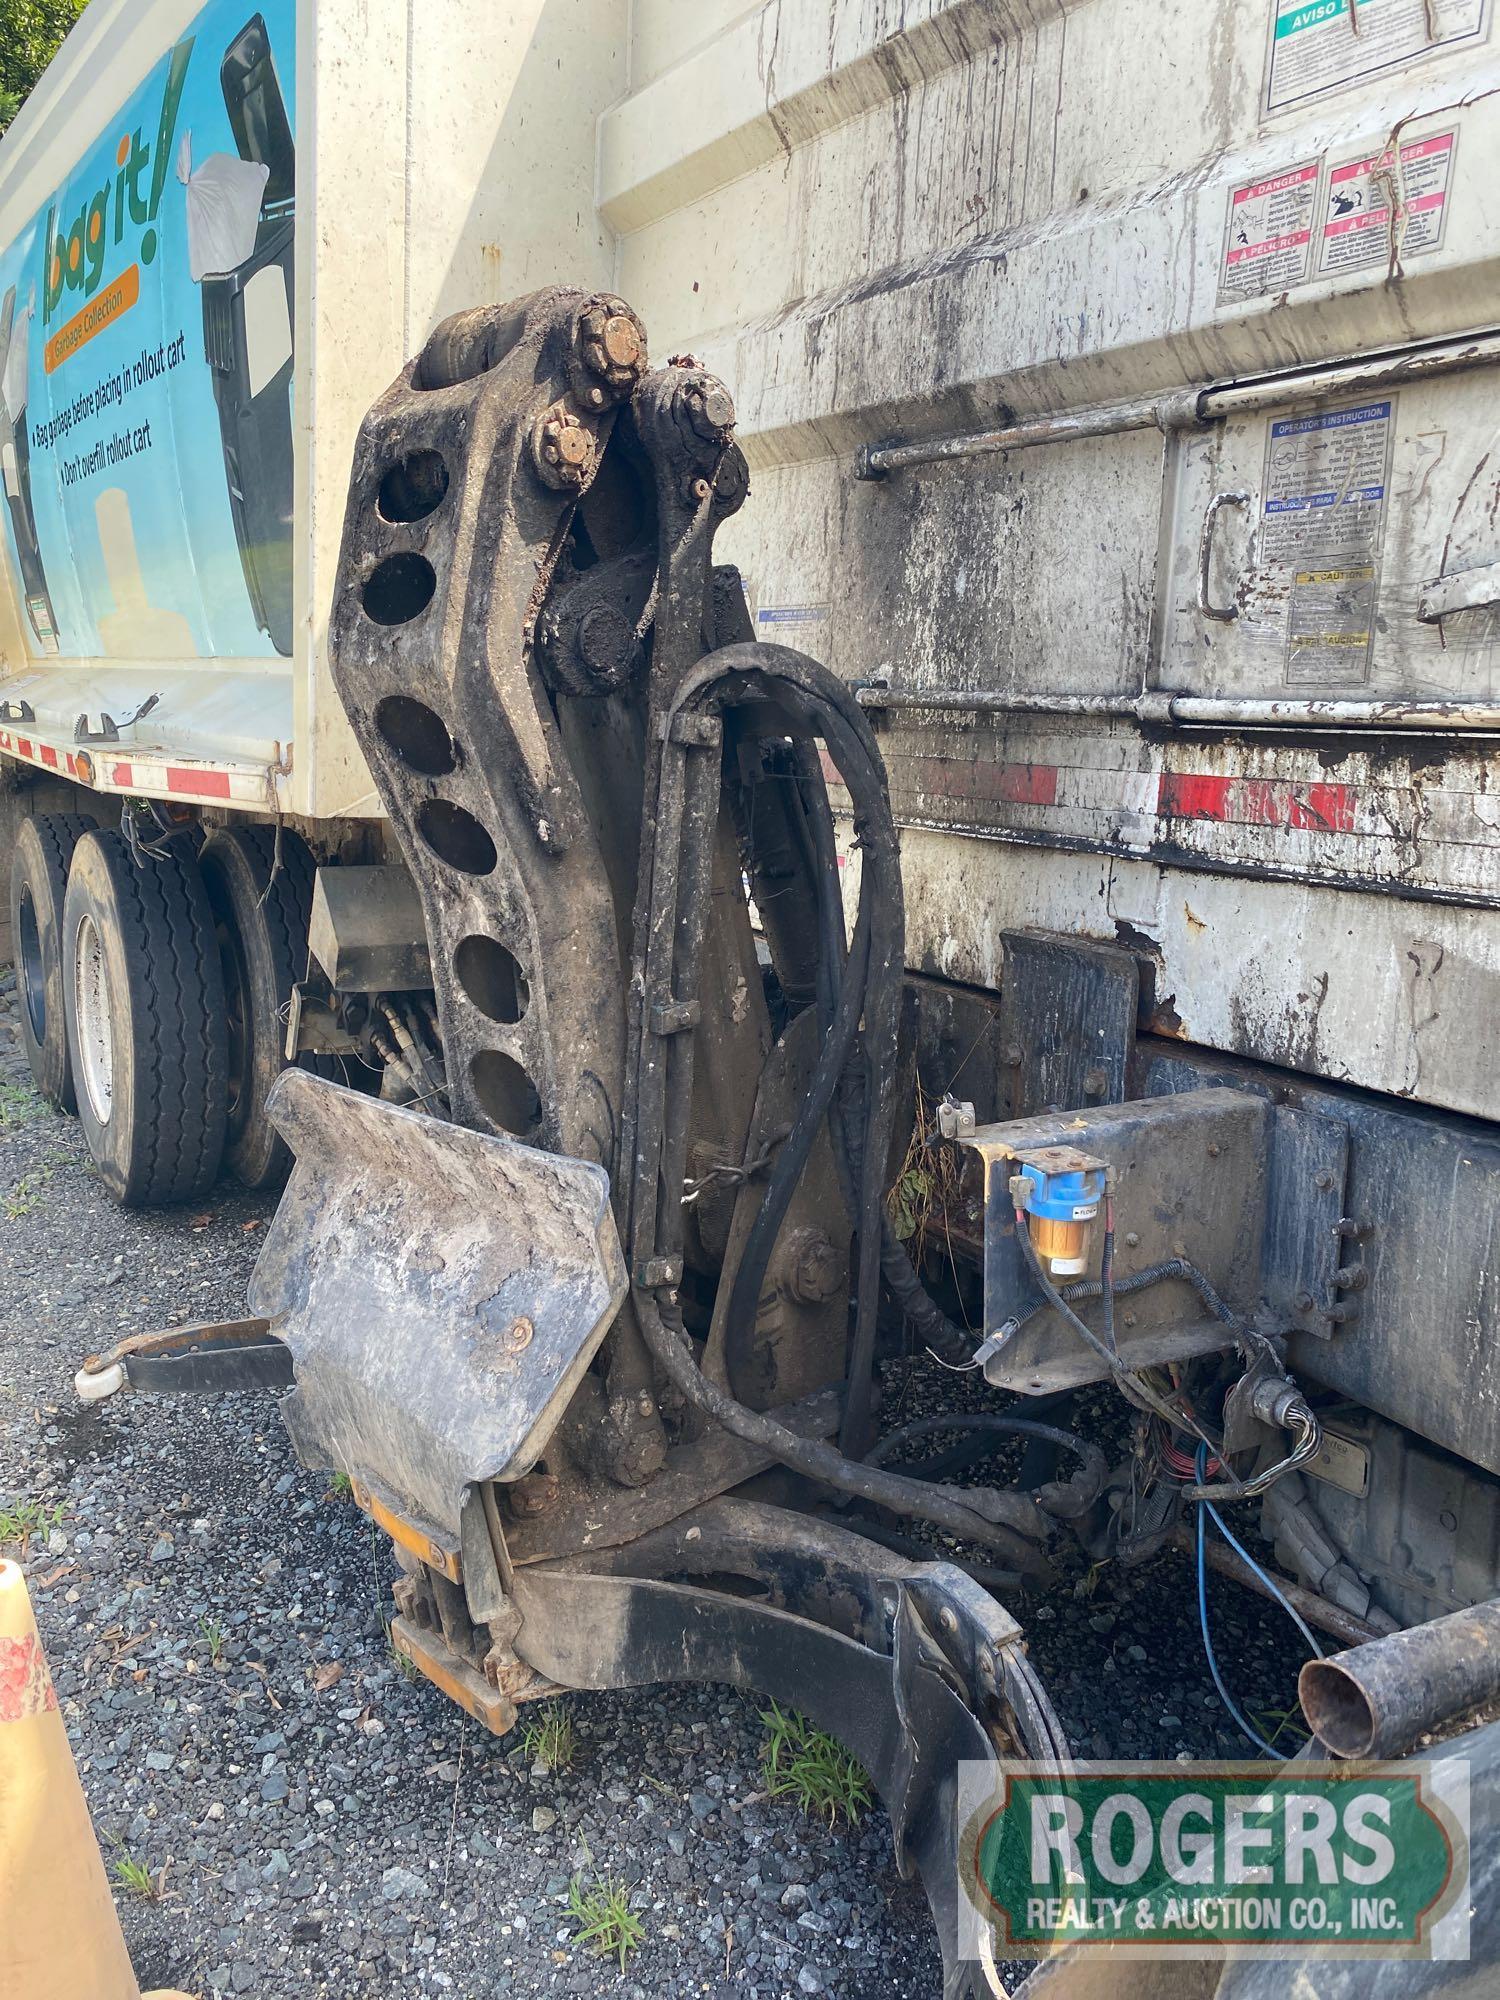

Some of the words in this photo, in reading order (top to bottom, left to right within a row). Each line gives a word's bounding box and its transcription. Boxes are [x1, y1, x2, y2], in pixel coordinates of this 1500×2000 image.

[1292, 2, 1336, 29] AVISO
[1258, 174, 1302, 193] DANGER
[1361, 202, 1416, 225] PELIO
[43, 178, 111, 326] bag
[55, 323, 82, 358] Garbage
[84, 289, 123, 332] Collection
[36, 423, 48, 449] Bag
[49, 410, 72, 447] garbage
[72, 393, 94, 425] before
[94, 373, 122, 418] placing
[123, 364, 132, 394] in
[133, 343, 166, 388] rollout
[167, 330, 186, 370] cart
[1279, 418, 1326, 433] OPERATOR'S
[1328, 408, 1382, 424] INSTRUCTION
[64, 455, 82, 486] Don't
[82, 440, 106, 477] overfill
[106, 429, 133, 465] rollout
[134, 419, 152, 454] cart
[1320, 572, 1363, 581] CAUTION
